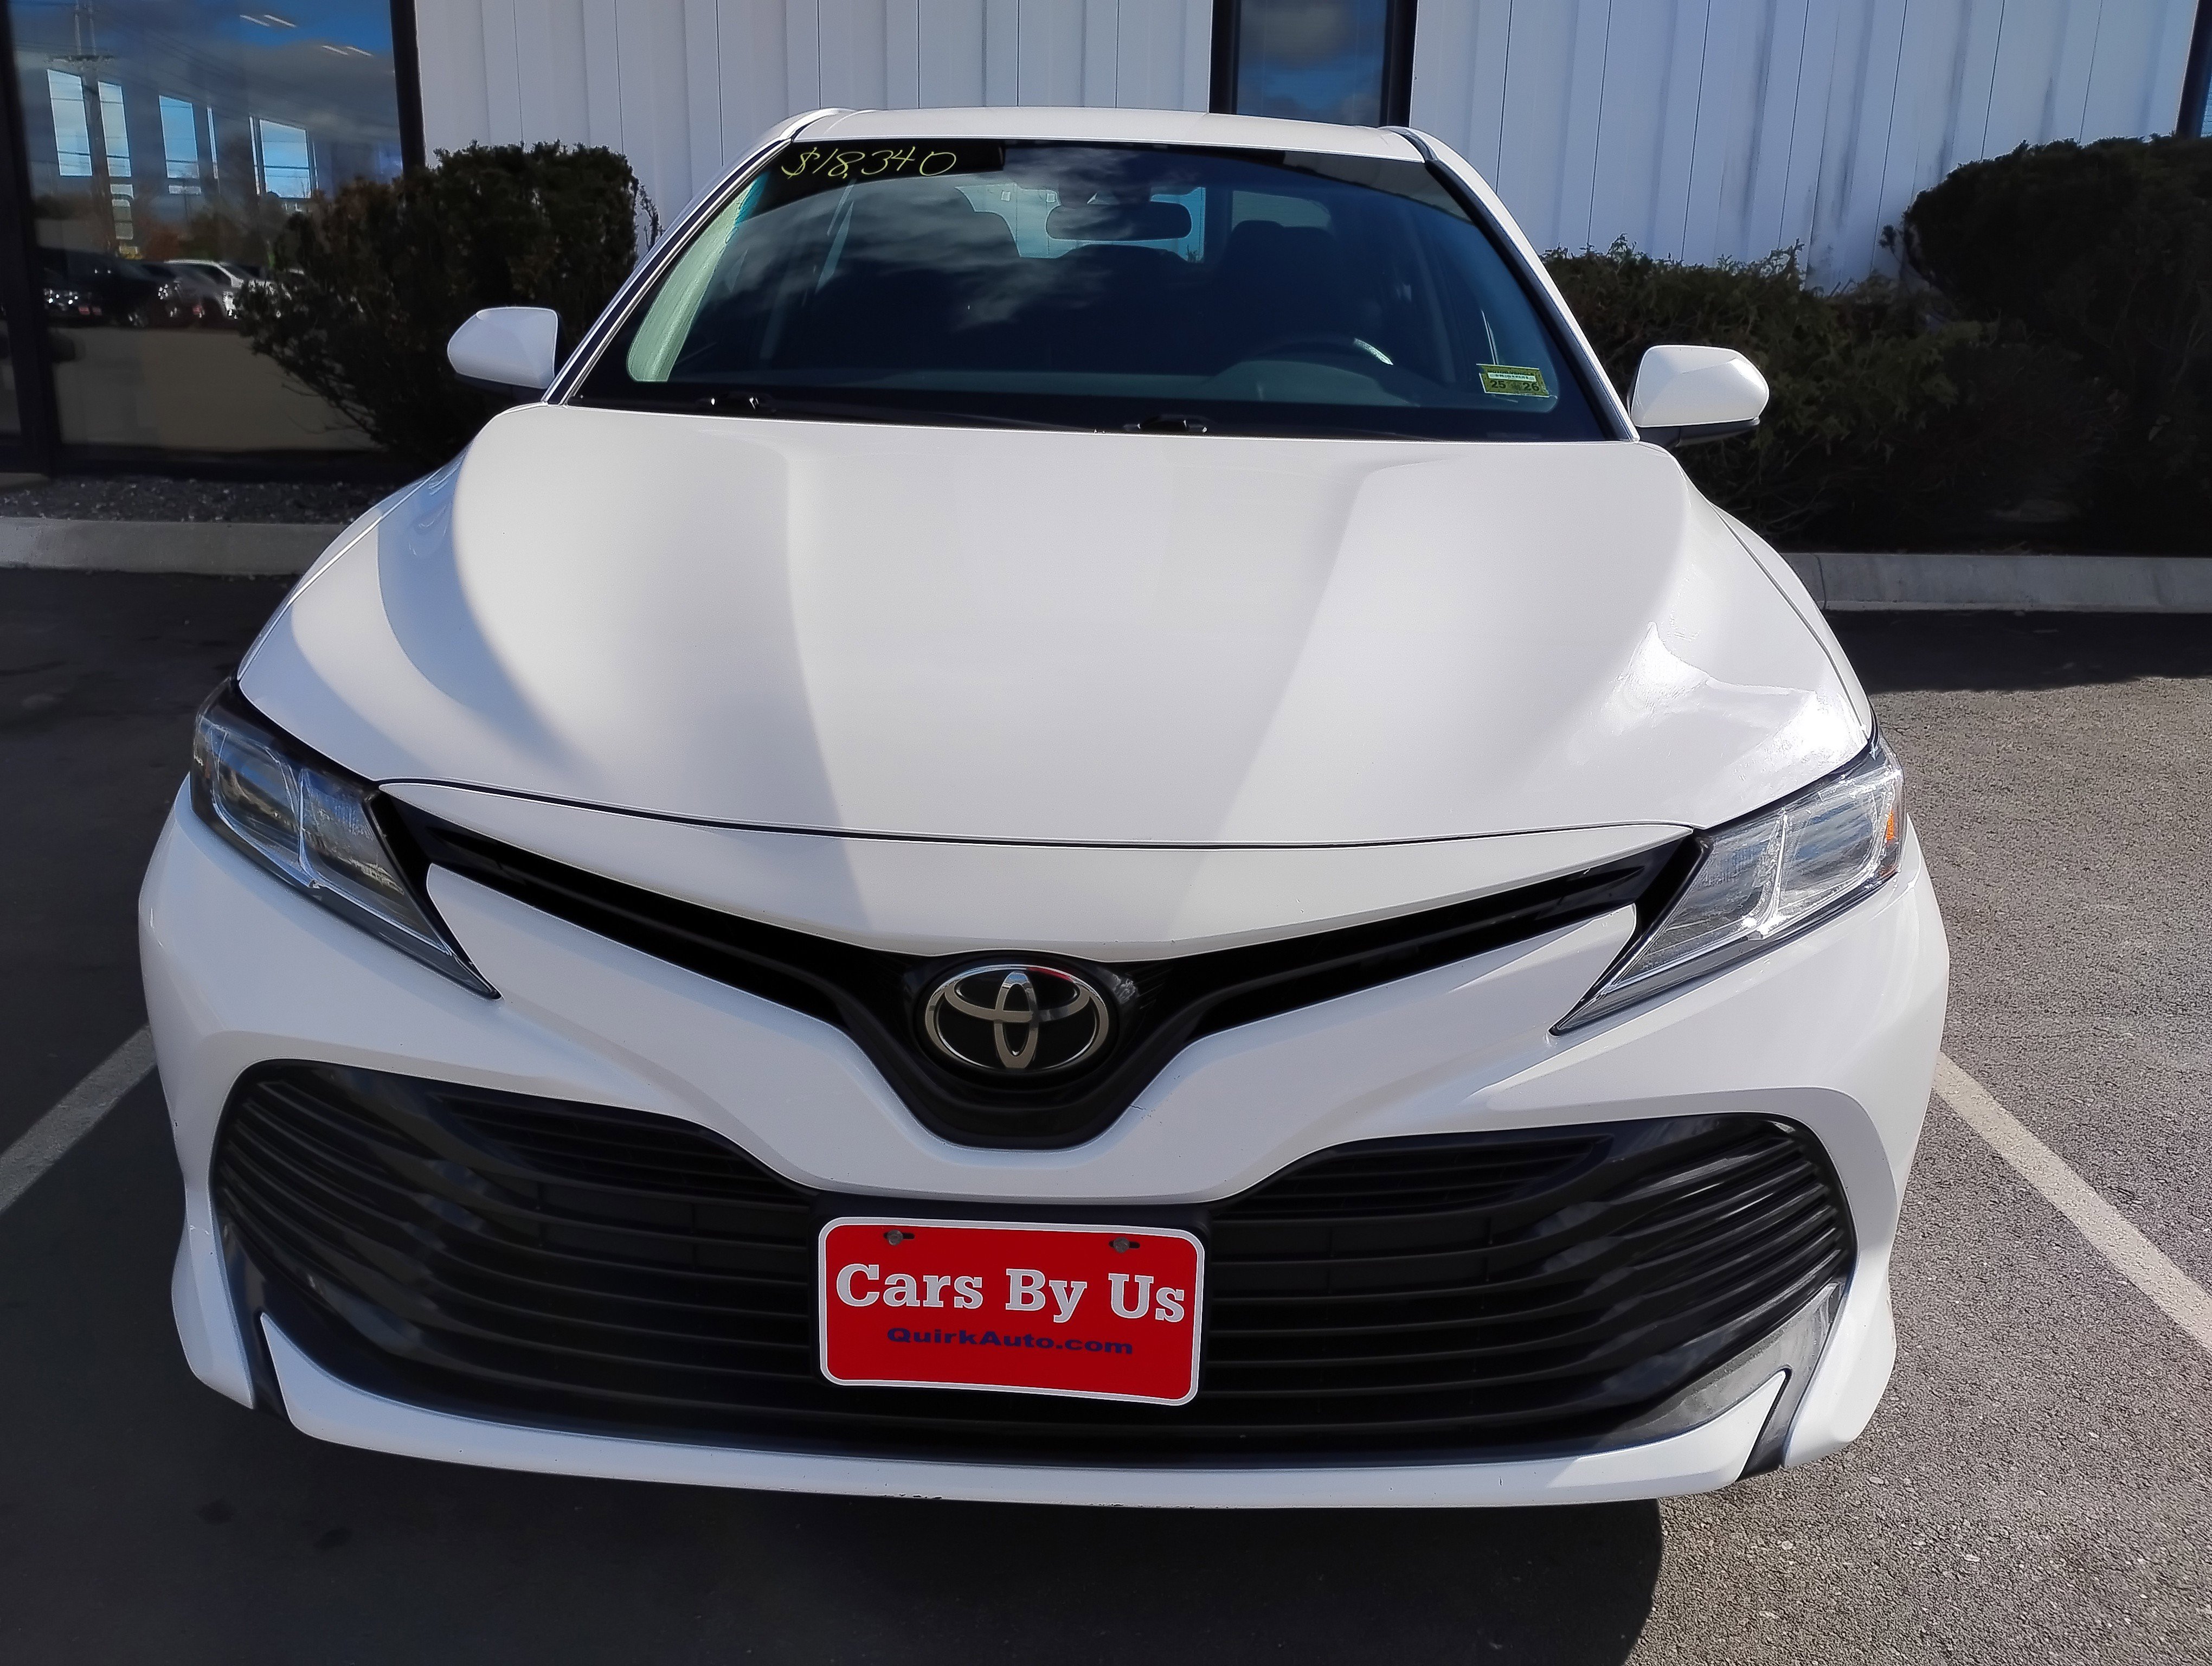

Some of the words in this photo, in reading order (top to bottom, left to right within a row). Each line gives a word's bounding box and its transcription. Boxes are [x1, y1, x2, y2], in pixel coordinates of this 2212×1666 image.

[781, 146, 956, 180] $18,340
[1490, 380, 1506, 389] 25
[1522, 382, 1540, 391] 26
[836, 1263, 983, 1309] Cars
[1005, 1268, 1088, 1323] By
[1108, 1273, 1186, 1322] Us
[887, 1328, 1133, 1355] QuirkAuto.com
